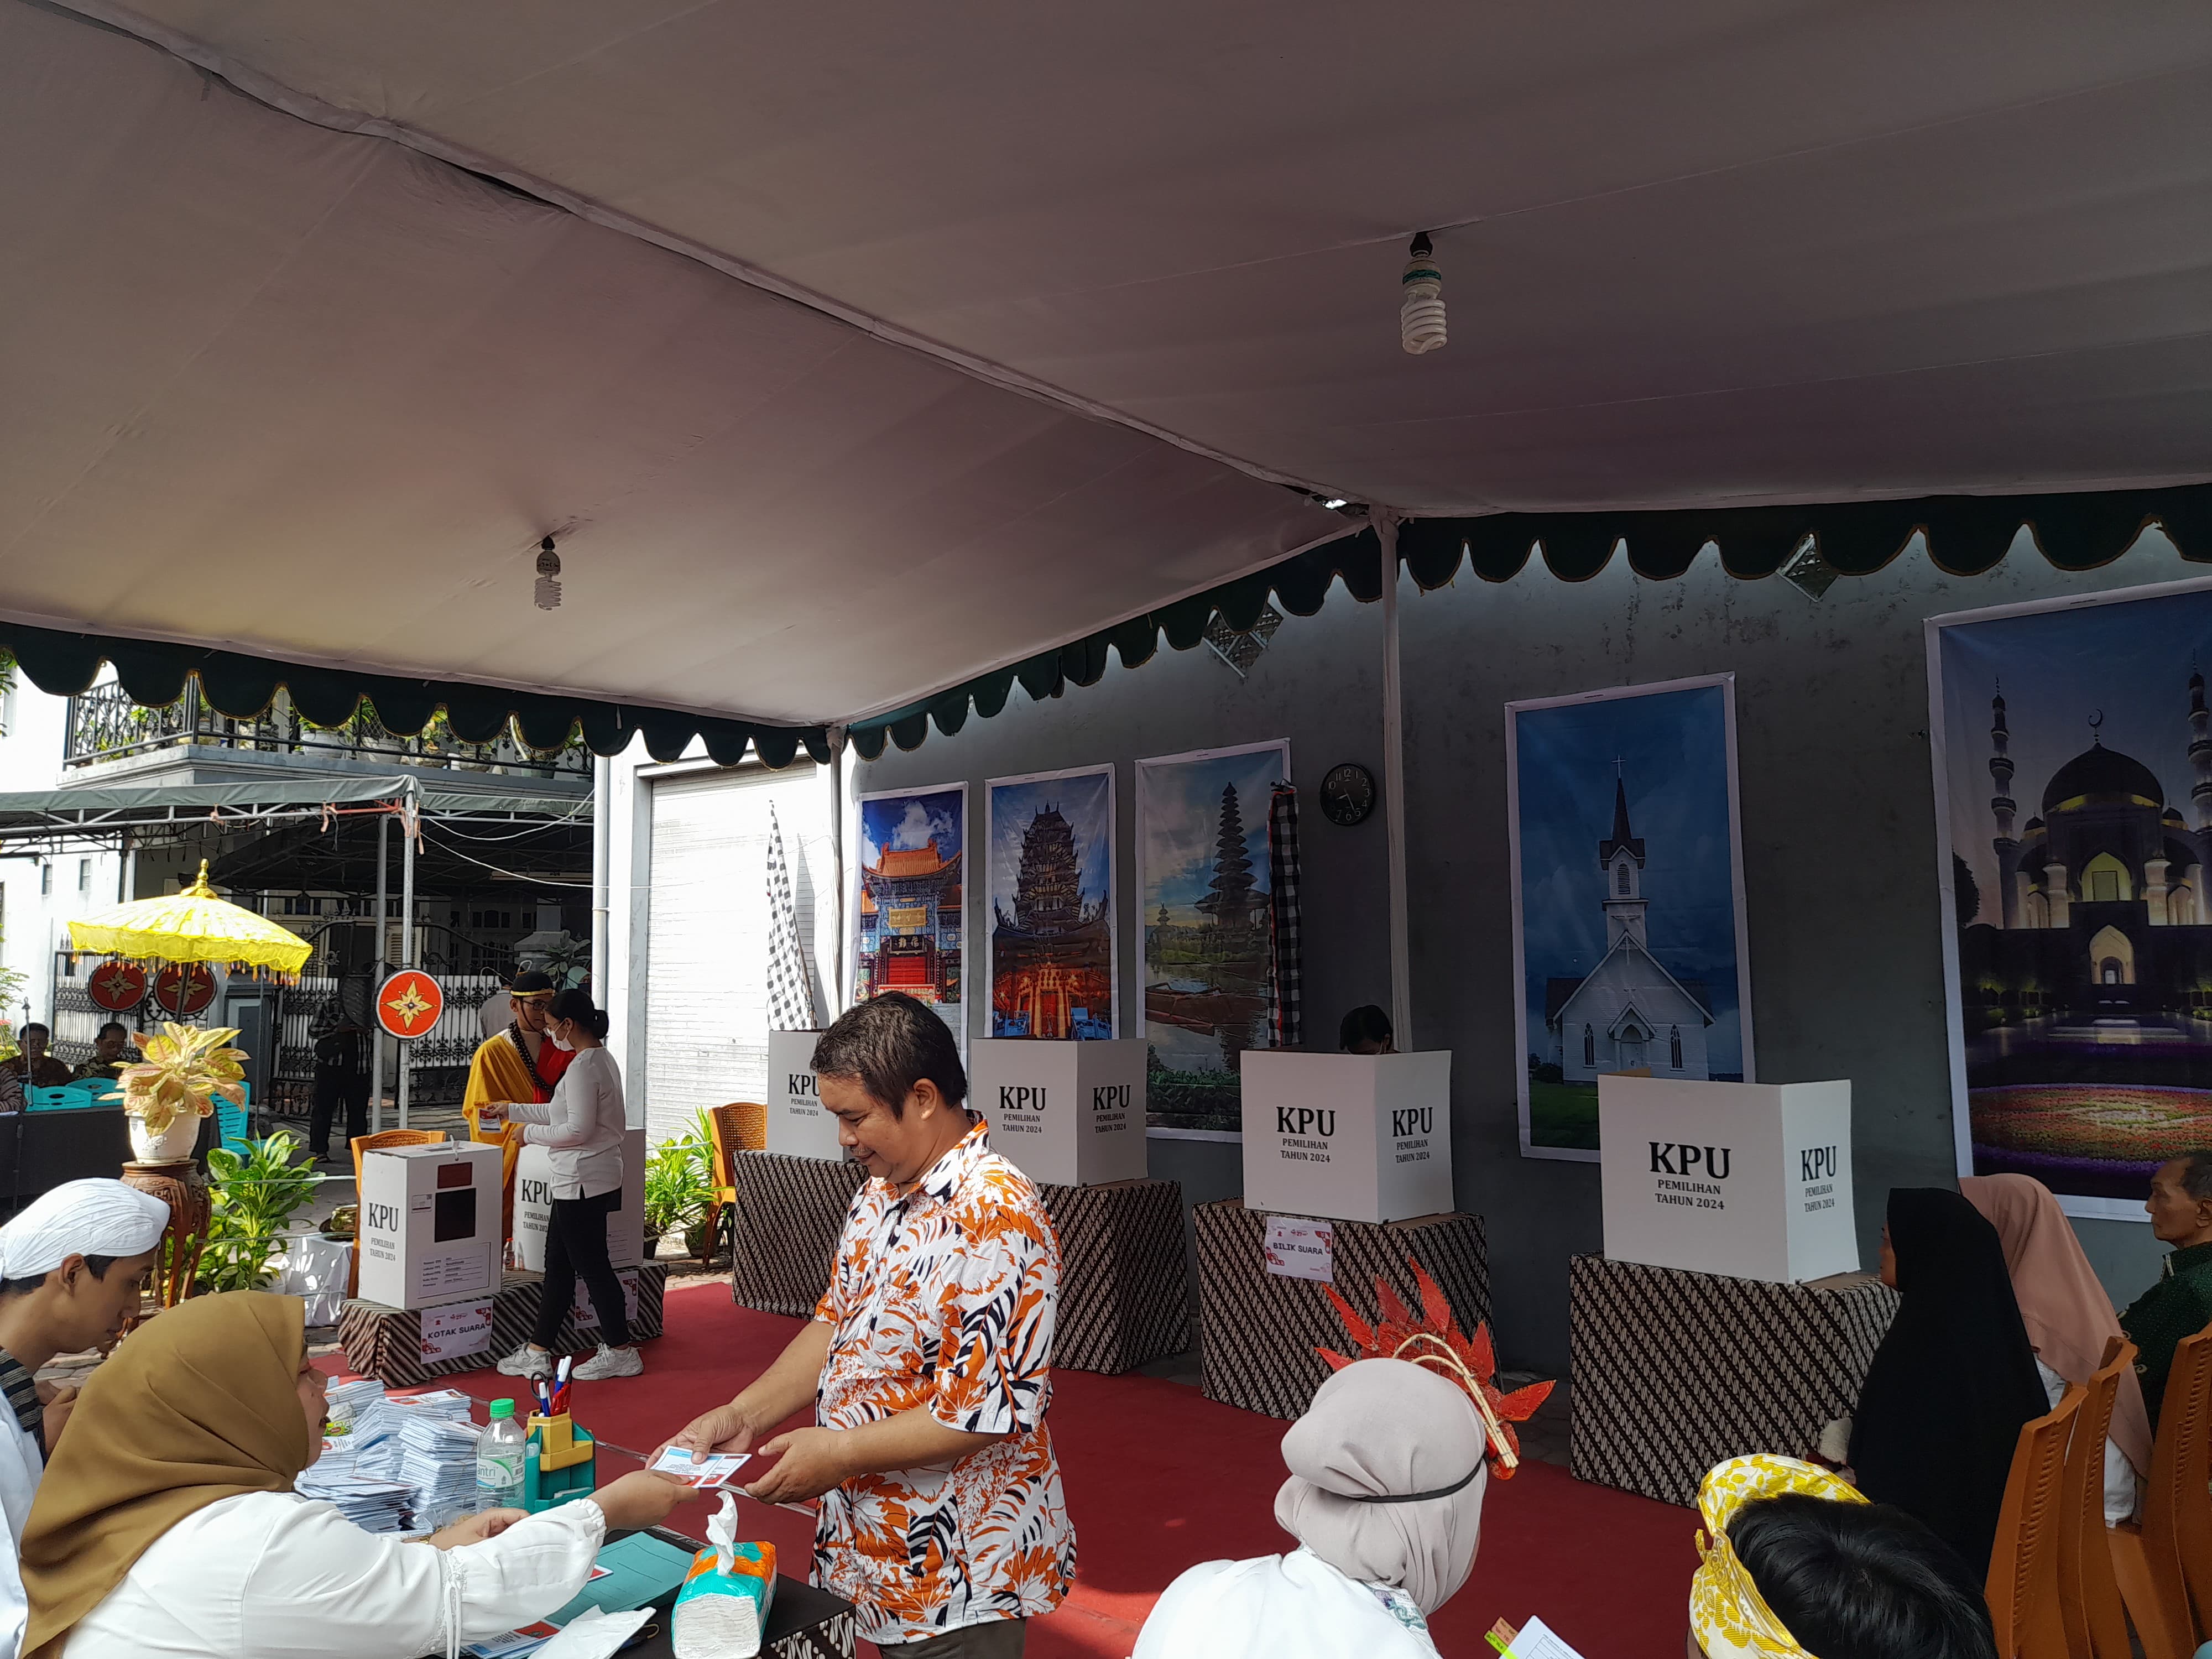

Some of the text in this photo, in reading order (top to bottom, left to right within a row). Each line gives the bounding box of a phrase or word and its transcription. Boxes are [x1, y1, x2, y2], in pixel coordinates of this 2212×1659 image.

[1344, 769, 1350, 778] 12
[1355, 770, 1358, 779] 1
[1328, 781, 1336, 790] 10
[1362, 778, 1366, 786] 2
[1365, 788, 1370, 797] 3
[1345, 811, 1352, 821] 6
[1354, 808, 1360, 817] 5
[791, 1098, 818, 1107] PEMILIHAN
[999, 1086, 1046, 1111] KPU
[1093, 1084, 1131, 1111] KPU
[789, 1107, 806, 1115] TAHUN
[1096, 1112, 1125, 1123] PEMILIHAN
[1004, 1113, 1041, 1123] PEMILIHAN
[1276, 1106, 1336, 1137] KPU
[1392, 1107, 1433, 1138] KPU
[1002, 1124, 1042, 1134] TAHUN 2024
[1094, 1123, 1126, 1134] TAHUN 2024
[1282, 1138, 1328, 1150] PEMILIHAN
[1396, 1139, 1428, 1151] PEMILIHAN
[1280, 1150, 1331, 1163] TAHUN 2024
[1395, 1151, 1430, 1164] TAHUN 2024
[1648, 1141, 1731, 1179] KPU
[1801, 1145, 1837, 1182] KPU
[521, 1178, 553, 1206] KPU
[1658, 1179, 1721, 1195] PEMILIHAN
[1805, 1183, 1833, 1198] PEMILIHAN
[1655, 1193, 1725, 1210] TAHUN 2024
[1804, 1197, 1835, 1212] TAHUN 2024
[368, 1202, 399, 1233] KPU
[522, 1220, 548, 1233] TAHUN 202
[371, 1237, 395, 1250] PEMILIHAN
[1273, 1242, 1323, 1255] BILIK SUARA
[369, 1248, 396, 1261] TAHUN 2024
[427, 1323, 486, 1339] KOTAK SUARA
